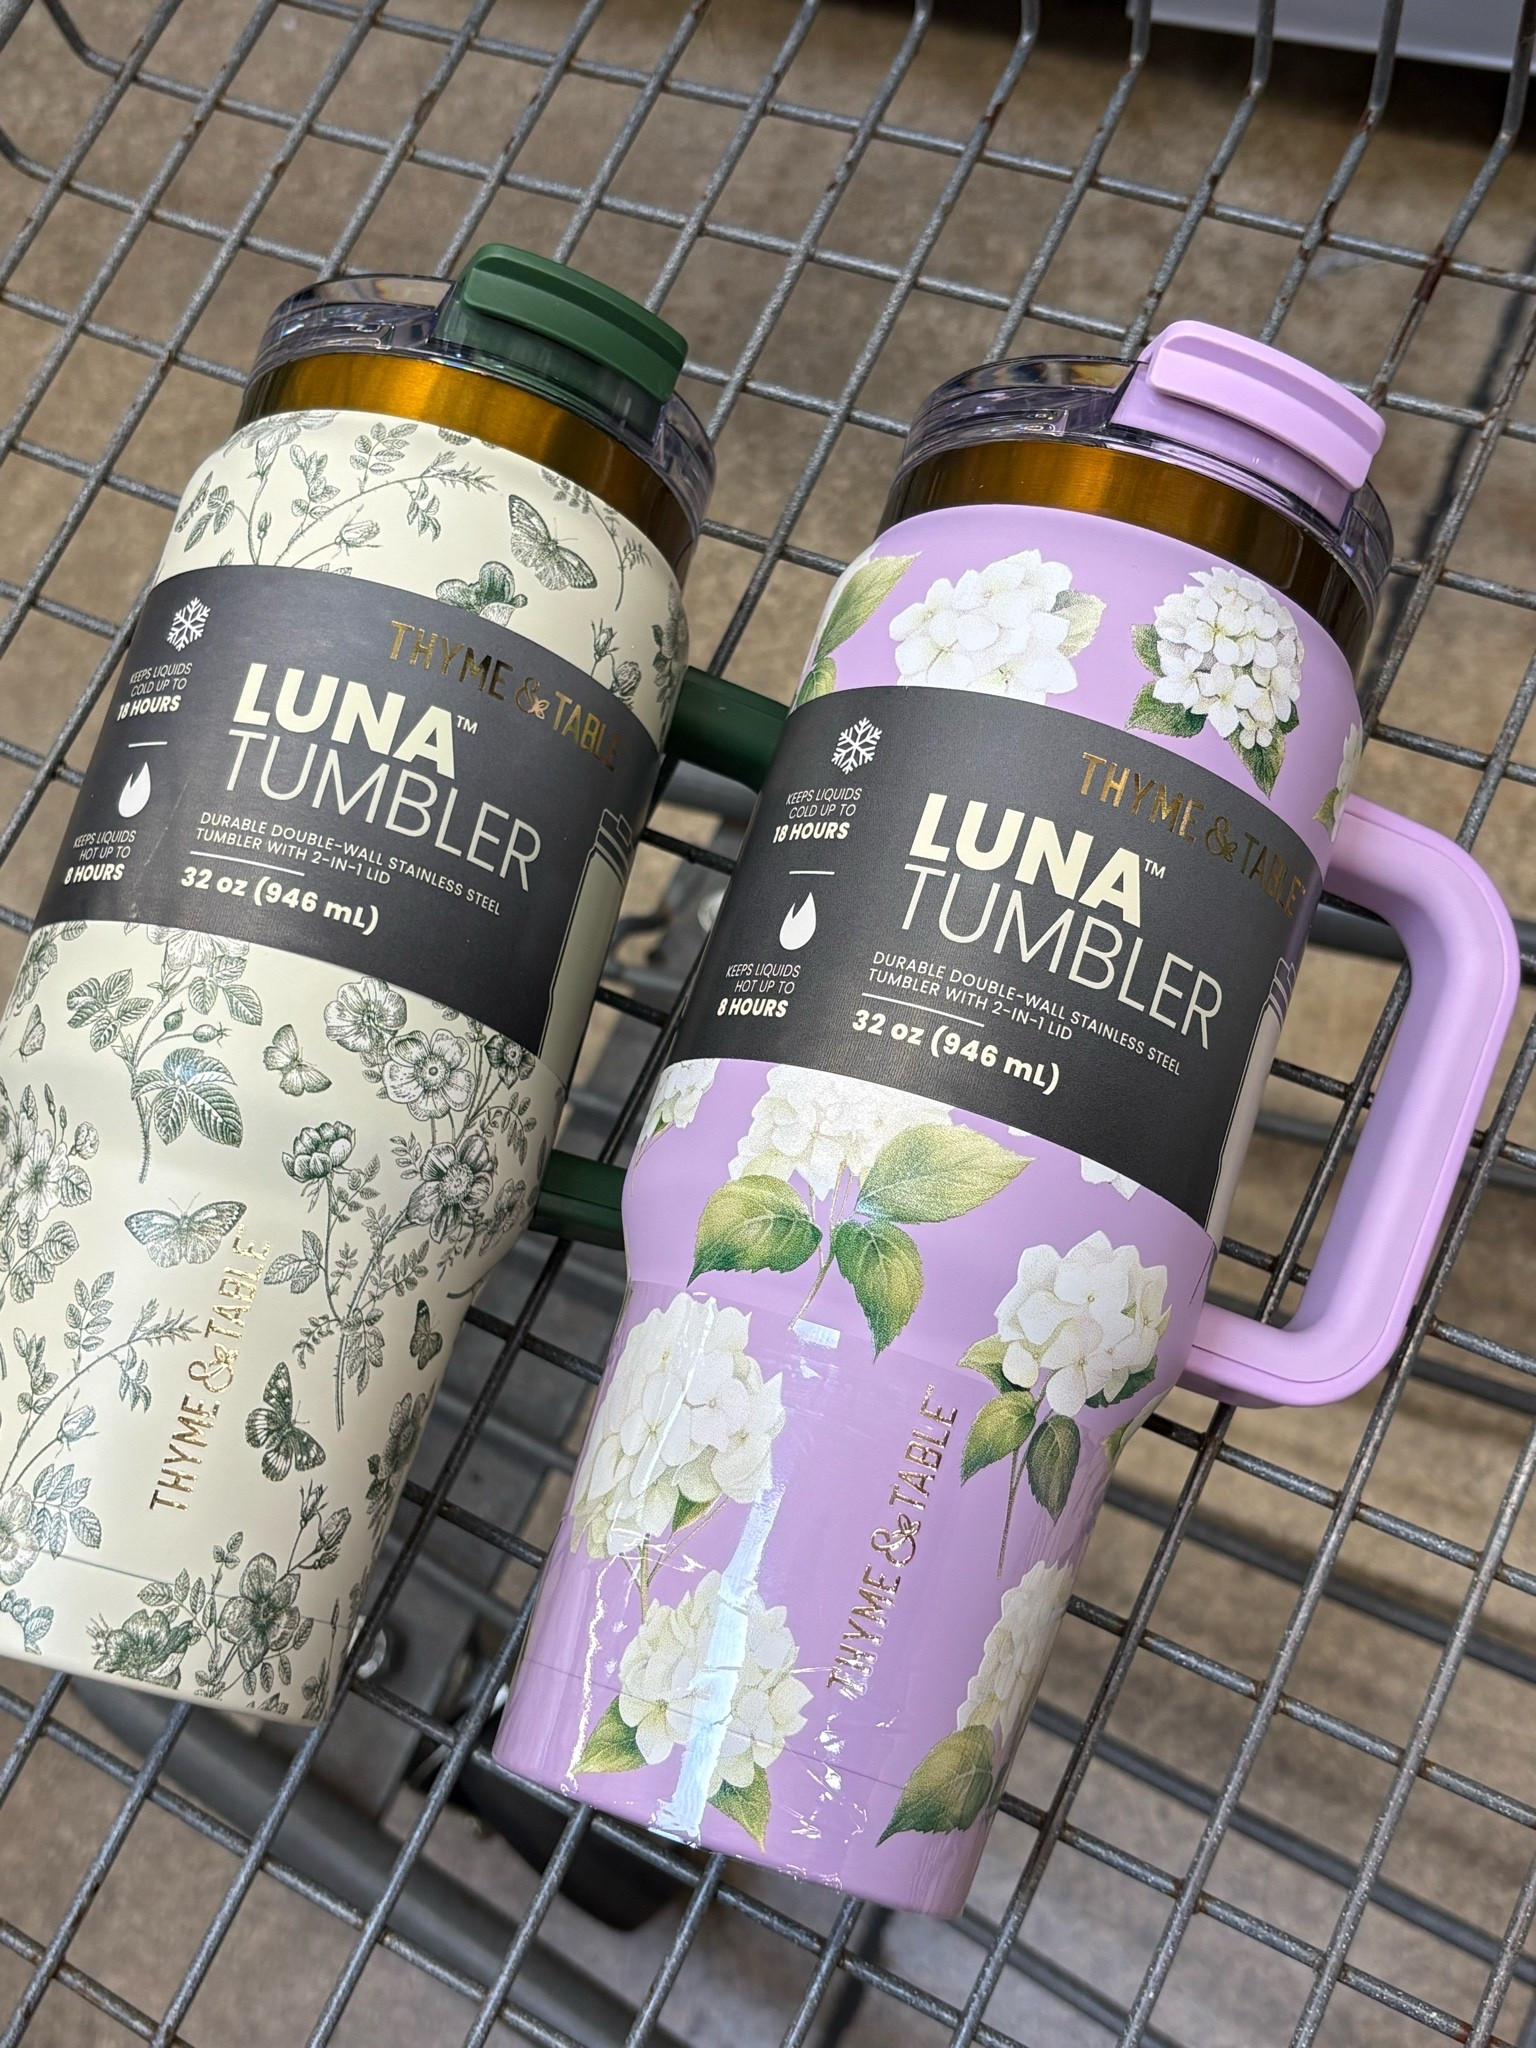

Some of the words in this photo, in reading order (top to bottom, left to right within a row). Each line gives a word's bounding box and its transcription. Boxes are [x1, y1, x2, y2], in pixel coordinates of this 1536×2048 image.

[130, 667, 152, 684] KEEPS
[153, 663, 192, 678] LIQUIDS
[389, 620, 513, 701] THYME
[117, 702, 129, 721] 18
[130, 695, 181, 716] HOURS
[131, 681, 154, 698] COLD
[156, 679, 170, 691] UP
[172, 677, 187, 690] TO
[226, 729, 541, 892] TUMBLER
[786, 789, 814, 805] KEEPS
[815, 787, 862, 802] LIQUIDS
[788, 804, 818, 819] COLD
[820, 804, 836, 817] UP
[839, 803, 857, 817] TO
[73, 832, 96, 849] KEEPS
[97, 829, 137, 845] LIQUIDS
[772, 824, 789, 843] 18
[789, 822, 850, 841] HOURS
[1080, 751, 1205, 843] THYME
[1240, 832, 1306, 920] TABLE
[64, 866, 74, 885] 8
[74, 863, 125, 883] HOURS
[79, 847, 98, 862] HOT
[99, 846, 114, 859] UP
[116, 845, 131, 858] TO
[196, 828, 261, 850] TUMBLER
[267, 842, 307, 861] WITH
[311, 851, 362, 876] 2-IN-1
[366, 867, 391, 885] LID
[200, 812, 267, 835] DURABLE
[271, 825, 383, 866] DOUBLE-WALL
[388, 858, 463, 896] STAINLESS
[466, 889, 501, 916] STEEL
[181, 866, 213, 889] 32
[216, 876, 250, 897] oz
[253, 876, 319, 913] (946
[323, 900, 379, 936] mL)
[726, 963, 753, 978] KEEPS
[754, 963, 801, 978] LIQUIDS
[901, 863, 1223, 1050] TUMBLER
[734, 980, 758, 993] HOT
[759, 981, 775, 993] UP
[779, 981, 795, 994] TO
[869, 968, 939, 996] TUMBLER
[945, 986, 988, 1011] WITH
[992, 1001, 1045, 1031] 2-IN-1
[1047, 1023, 1073, 1041] LID
[716, 998, 728, 1016] 8
[728, 998, 789, 1018] HOURS
[873, 951, 947, 979] DURABLE
[949, 969, 1066, 1020] DOUBLE-WALL
[1070, 1011, 1145, 1055] STAINLESS
[1147, 1047, 1181, 1076] STEEL
[852, 1009, 887, 1035] 32
[890, 1022, 925, 1046] oz
[930, 1025, 998, 1067] (946
[1003, 1056, 1060, 1096] mL)
[149, 1392, 221, 1511] THYME
[204, 1236, 271, 1340] TABLE
[827, 1563, 901, 1697] THYME
[889, 1395, 958, 1511] TABLE
